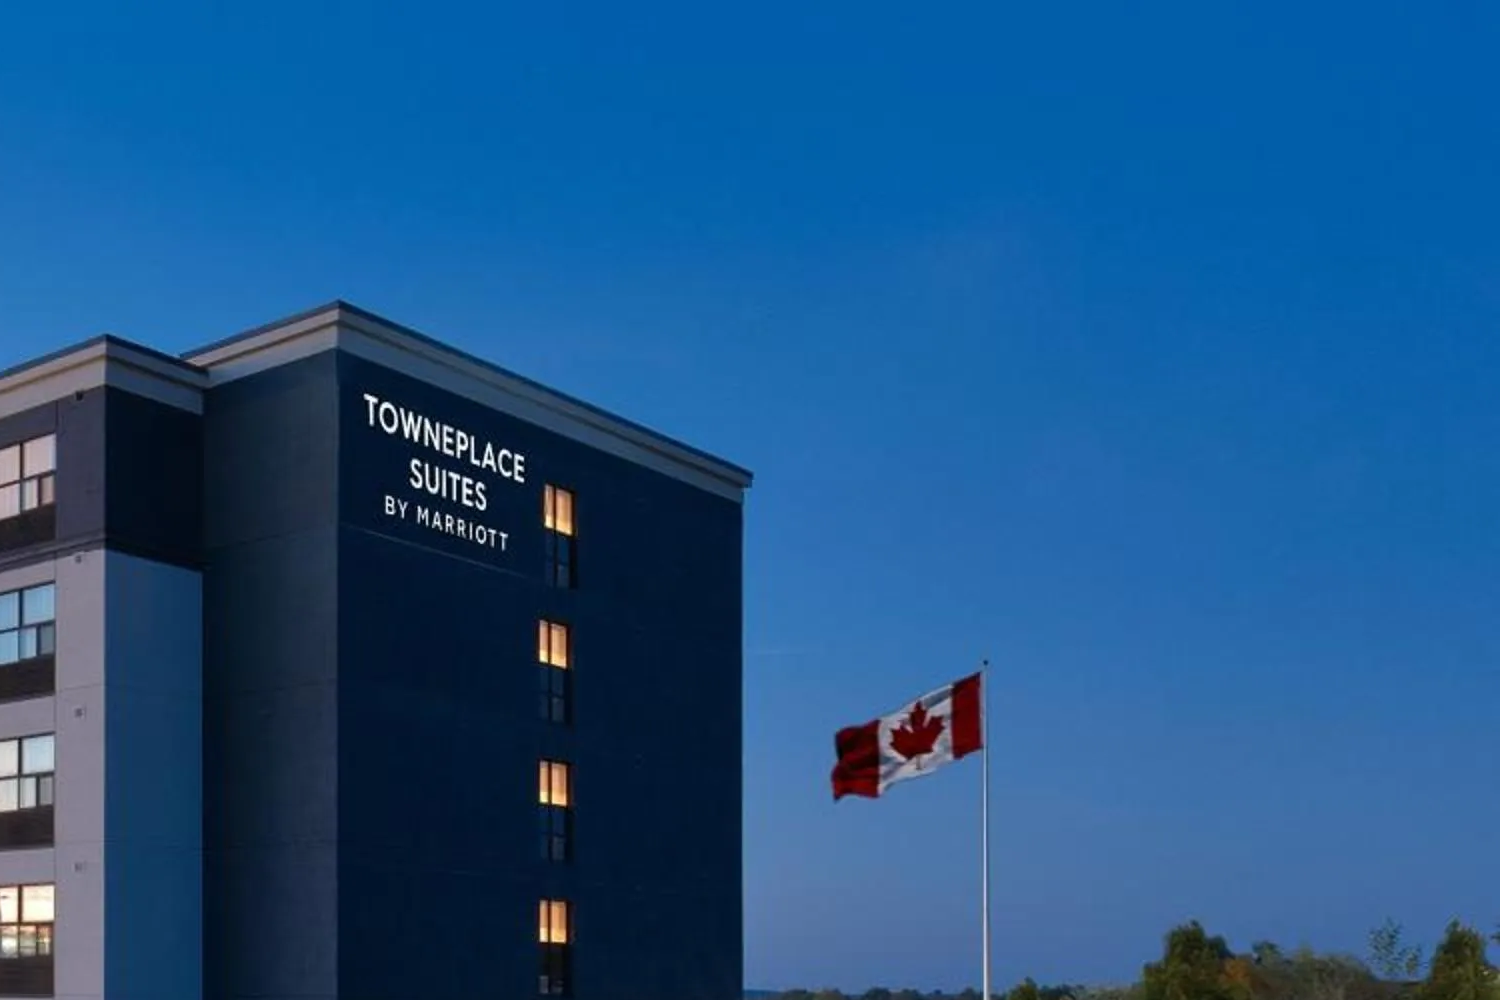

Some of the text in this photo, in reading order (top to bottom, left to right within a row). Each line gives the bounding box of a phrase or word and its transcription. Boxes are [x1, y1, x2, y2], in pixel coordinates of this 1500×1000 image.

[363, 393, 525, 484] TOWNEPLACE
[409, 458, 487, 511] SUITES
[385, 495, 509, 551] BY MARRIOTT
